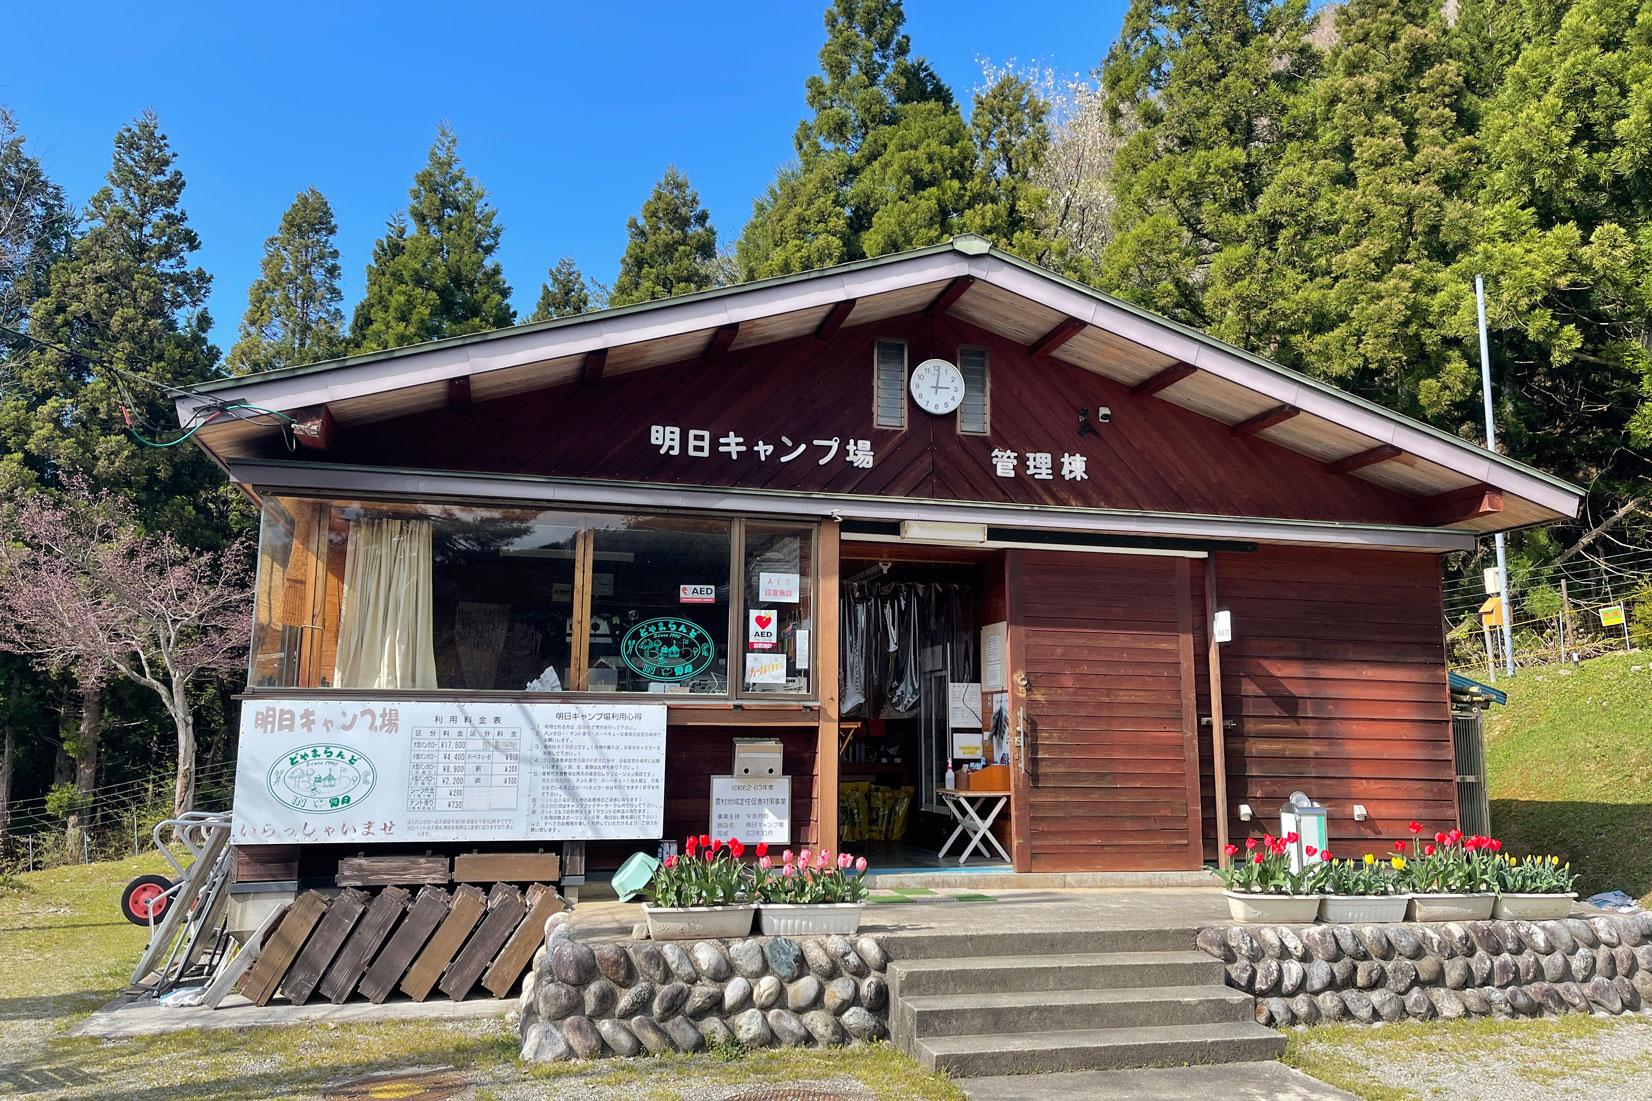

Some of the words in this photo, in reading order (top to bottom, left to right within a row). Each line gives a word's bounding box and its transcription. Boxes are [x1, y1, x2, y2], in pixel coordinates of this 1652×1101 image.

[650, 425, 876, 469] 明日キャンプ場
[991, 448, 1089, 482] 管理棟
[766, 578, 791, 586] AED
[642, 663, 656, 674] IN
[254, 706, 399, 735] 明日キャンプ場
[434, 715, 502, 724] 利用料金表
[555, 713, 642, 721] 明日キャンプ場利用心得
[288, 746, 362, 766] どやまらんど
[240, 820, 396, 837] いらっしゃいませ
